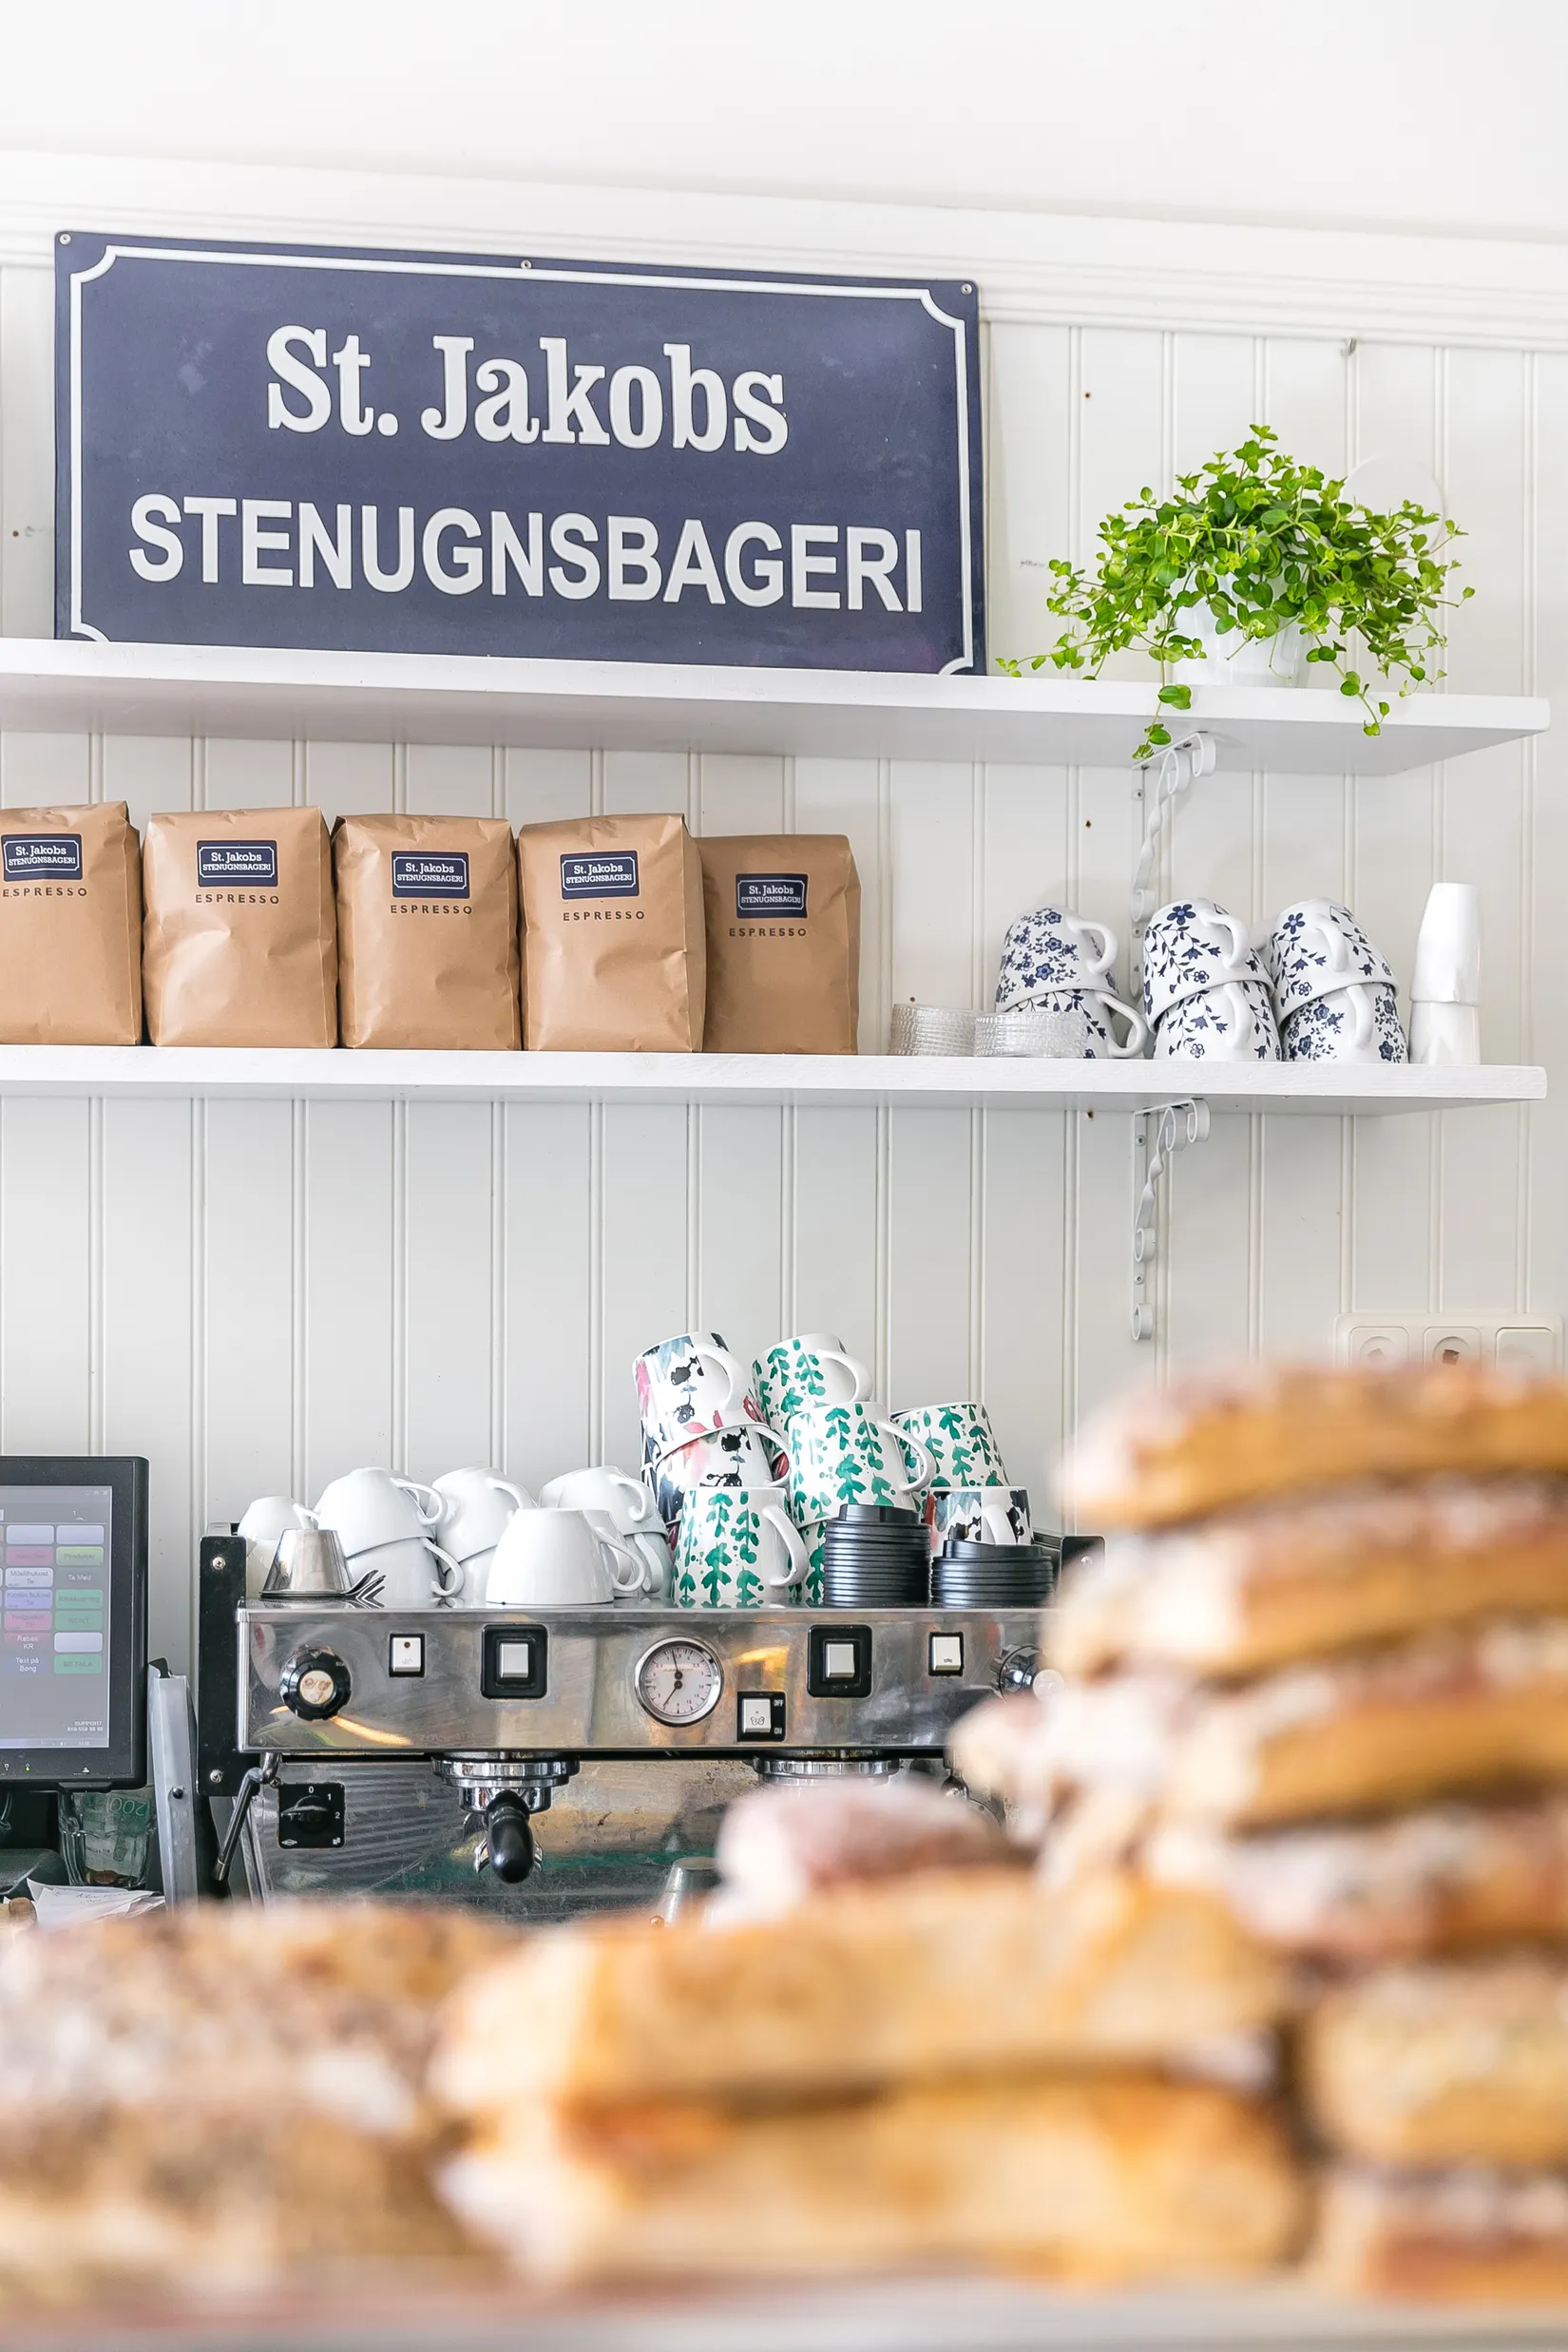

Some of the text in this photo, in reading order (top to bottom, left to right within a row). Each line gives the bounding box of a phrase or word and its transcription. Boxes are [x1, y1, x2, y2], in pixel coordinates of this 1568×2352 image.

[267, 324, 788, 454] St. Jakobs
[129, 493, 922, 613] STENUGNSBAGERI
[15, 846, 67, 857] St. Jakobs
[9, 856, 76, 866] STENUGNSBAGERI
[211, 852, 262, 863] St. Jakobs
[405, 863, 454, 874] St. Jakobs
[574, 863, 623, 875] St. Jakobs
[565, 874, 632, 884] STENUGNSBAGERI
[3, 888, 87, 897] ESPRESSO
[749, 885, 794, 896] St. Jakobs
[196, 894, 279, 904] ESPRESSO
[391, 905, 472, 914] ESPRESSO
[563, 911, 644, 921] ESPRESSO
[729, 928, 807, 937] ESPRESSO
[774, 1727, 783, 1735] ON
